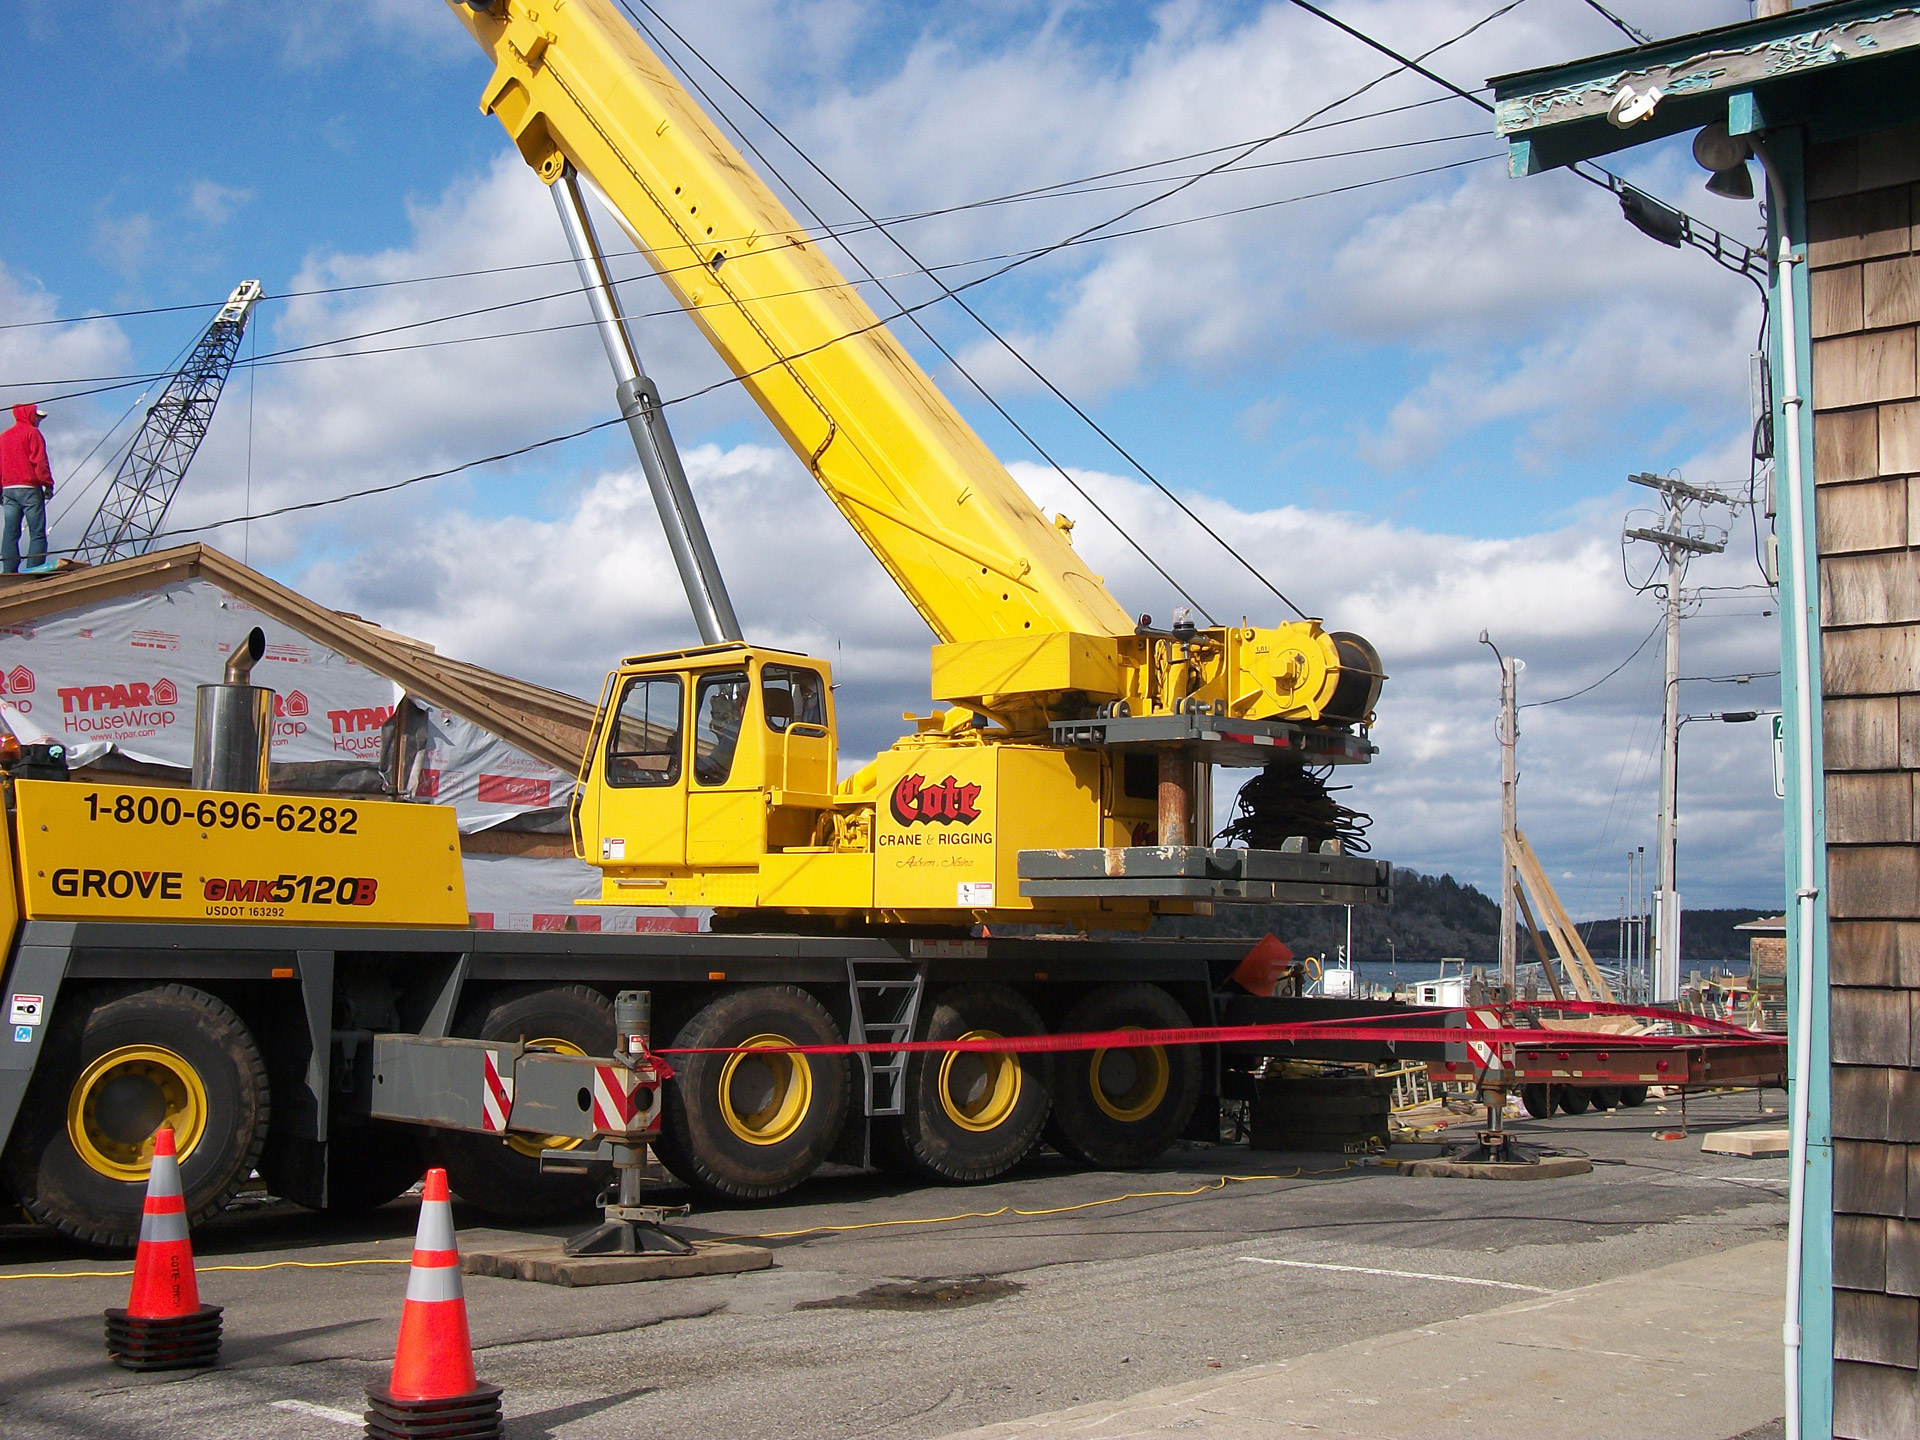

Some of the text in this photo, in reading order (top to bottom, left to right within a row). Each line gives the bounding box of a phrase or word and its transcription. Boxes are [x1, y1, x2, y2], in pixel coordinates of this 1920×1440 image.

[57, 682, 153, 713] TYPAR
[64, 710, 176, 734] HouseWrap
[327, 706, 394, 734] TYPA
[90, 729, 156, 741] www.typar.com
[333, 735, 382, 752] House
[83, 792, 358, 835] 1-800-696-6282
[889, 773, 982, 828] Cote
[878, 832, 993, 846] CRANE & RIGGING
[52, 868, 183, 900] GROVE
[203, 874, 378, 906] GMK5120B
[205, 906, 285, 917] USDOT 163292
[1477, 1043, 1483, 1051] B
